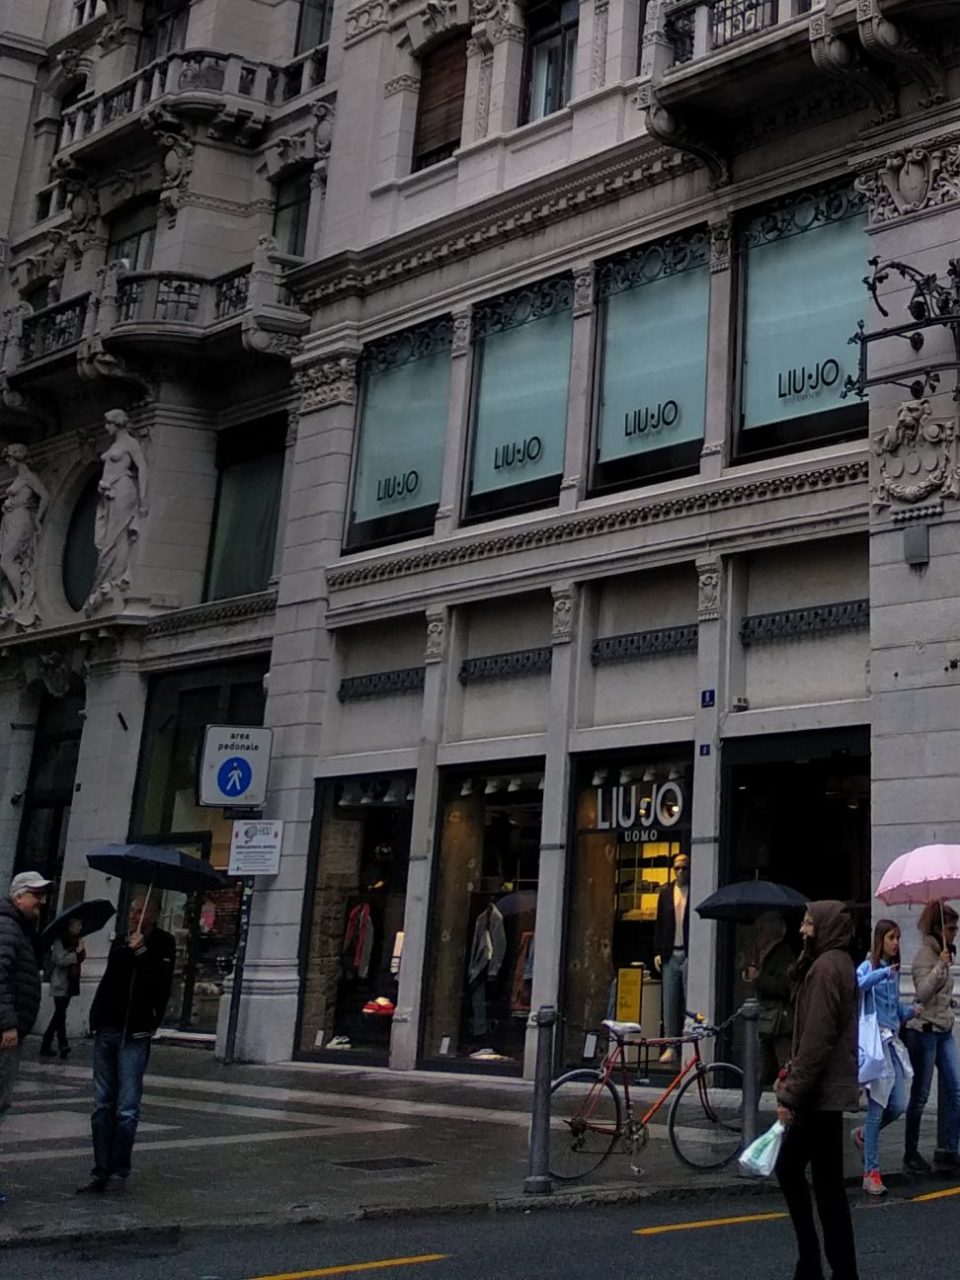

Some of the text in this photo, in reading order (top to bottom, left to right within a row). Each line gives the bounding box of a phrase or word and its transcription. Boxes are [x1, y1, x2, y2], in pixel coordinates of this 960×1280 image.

[230, 732, 250, 740] area
[217, 742, 259, 751] pedonale
[624, 829, 658, 842] UOMO
